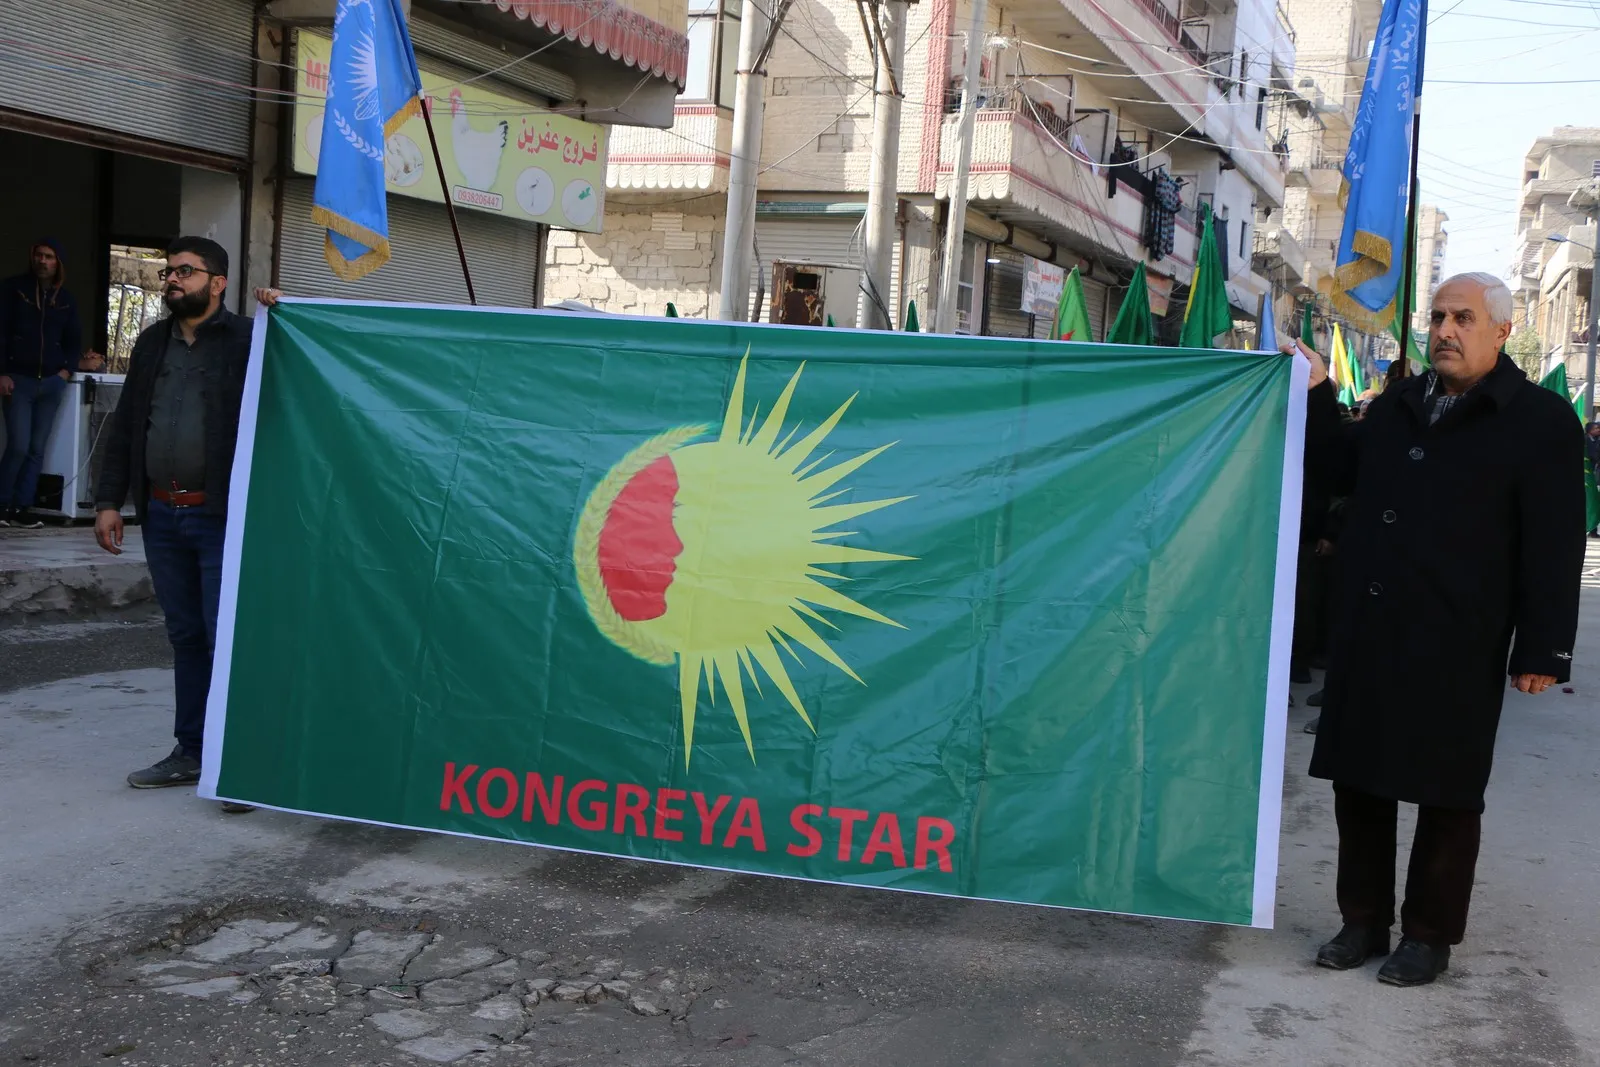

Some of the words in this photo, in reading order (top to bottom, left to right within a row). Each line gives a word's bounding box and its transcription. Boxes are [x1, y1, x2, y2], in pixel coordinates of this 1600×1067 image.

[517, 117, 559, 154] عفرين
[562, 133, 598, 166] فروج
[439, 761, 767, 852] KONGREYA
[786, 803, 955, 873] STAR
